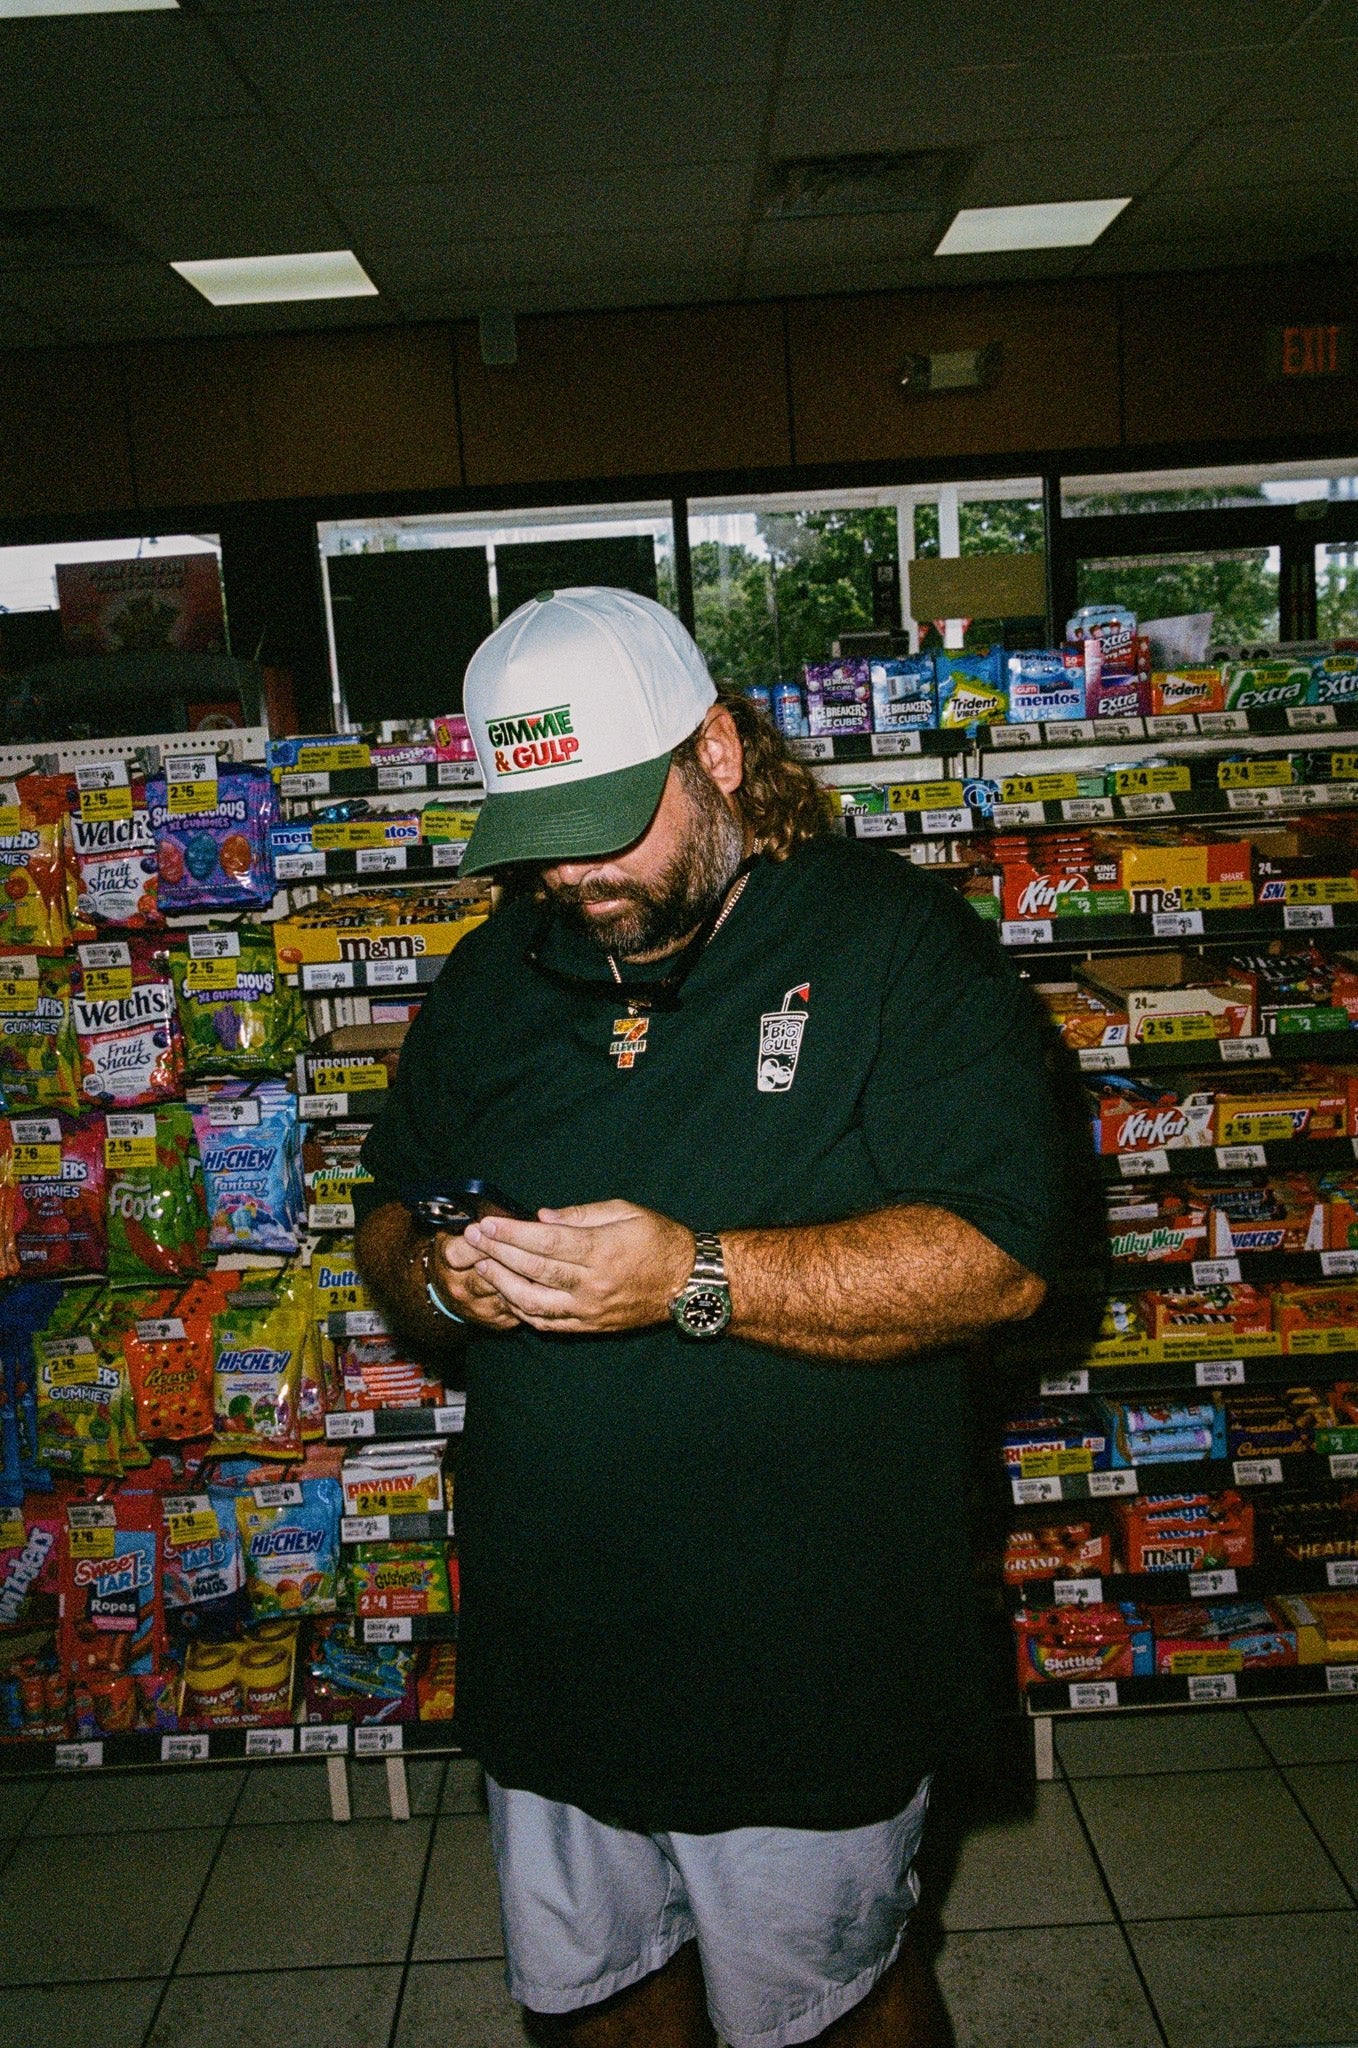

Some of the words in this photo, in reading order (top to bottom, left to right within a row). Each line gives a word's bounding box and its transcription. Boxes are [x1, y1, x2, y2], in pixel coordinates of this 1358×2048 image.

[1282, 325, 1339, 375] EXIT
[1101, 631, 1131, 648] xtra
[1159, 681, 1207, 696] Trident
[1237, 682, 1302, 709] Extra
[951, 696, 998, 711] Trident
[1015, 691, 1081, 706] mentos
[1098, 692, 1138, 714] Extra
[811, 705, 826, 719] ICE
[826, 703, 867, 718] BREAKERS
[877, 703, 891, 716] ICE
[891, 700, 932, 714] BREAKERS
[957, 709, 980, 718] VIBES
[834, 716, 864, 728] CUBES
[900, 713, 929, 725] CUBES
[488, 710, 574, 748] GIMME
[494, 750, 512, 772] &
[513, 736, 580, 769] GULP
[1120, 774, 1129, 787] 2
[1222, 768, 1231, 780] 2
[171, 787, 178, 798] 2
[893, 790, 901, 803] 2
[1006, 783, 1015, 796] 2
[84, 795, 91, 807] 2
[841, 804, 869, 816] dent
[76, 816, 156, 849] Welch's
[272, 831, 313, 845] men
[0, 855, 29, 866] MIES
[97, 862, 130, 878] Fruit
[1094, 864, 1117, 873] KING
[1259, 863, 1271, 875] 24
[88, 875, 139, 890] Snacks
[1097, 872, 1117, 881] SIZE
[1185, 888, 1193, 902] 2
[1290, 884, 1298, 897] 2
[340, 935, 425, 960] m&m's
[190, 962, 197, 973] 2
[85, 974, 93, 985] 2
[78, 991, 168, 1028] Welch's
[1135, 997, 1148, 1009] 24
[4, 1020, 58, 1036] GUMMIES
[1147, 1021, 1155, 1035] 2
[107, 1040, 146, 1060] Fruit
[763, 1039, 798, 1051] GULP
[97, 1054, 151, 1073] Snacks
[318, 1072, 327, 1086] 2
[1119, 1113, 1189, 1146] KitKat
[1225, 1123, 1233, 1137] 2
[14, 1147, 22, 1159] 2
[108, 1141, 116, 1153] 2
[204, 1146, 275, 1172] HI-CHEW
[23, 1181, 80, 1199] GUMMIES
[213, 1176, 267, 1193] fantasy
[320, 1184, 329, 1196] 2
[1150, 1227, 1184, 1248] Way
[330, 1291, 338, 1304] 2
[51, 1359, 60, 1372] 2
[216, 1350, 292, 1374] HI-CHEW
[144, 1368, 198, 1387] Reese's
[48, 1385, 111, 1405] GUMMIES
[1004, 1443, 1065, 1464] RUNCH
[361, 1496, 369, 1509] 2
[171, 1517, 180, 1529] 2
[71, 1532, 79, 1543] 2
[251, 1529, 324, 1556] HI-CHEW
[91, 1598, 136, 1614] Ropes
[361, 1595, 369, 1611] 2
[1044, 1655, 1103, 1672] Skittles
